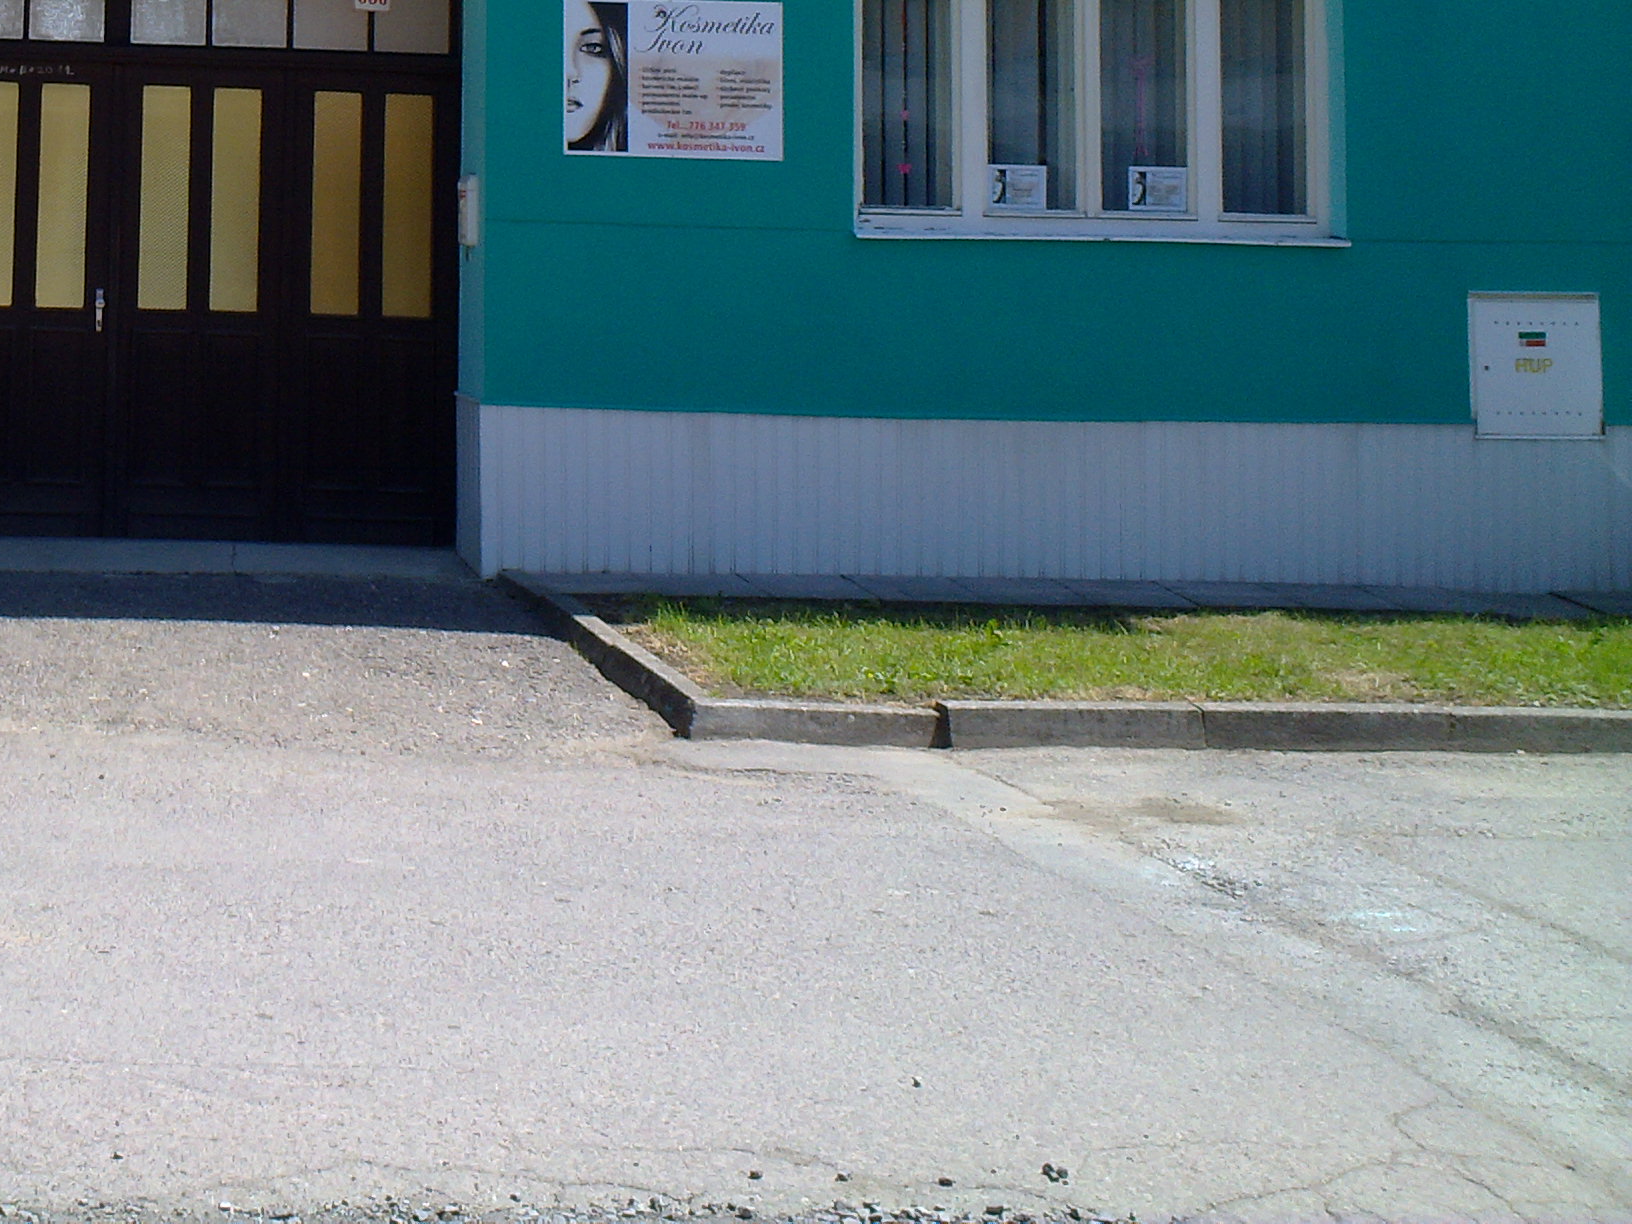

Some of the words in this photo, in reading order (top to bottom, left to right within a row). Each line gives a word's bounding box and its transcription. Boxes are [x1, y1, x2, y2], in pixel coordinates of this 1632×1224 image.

[644, 5, 775, 35] Kosmetika
[634, 28, 703, 54] Ivon
[647, 141, 765, 153] www.kosmetika-ivon.cz
[1514, 358, 1553, 374] HUP
